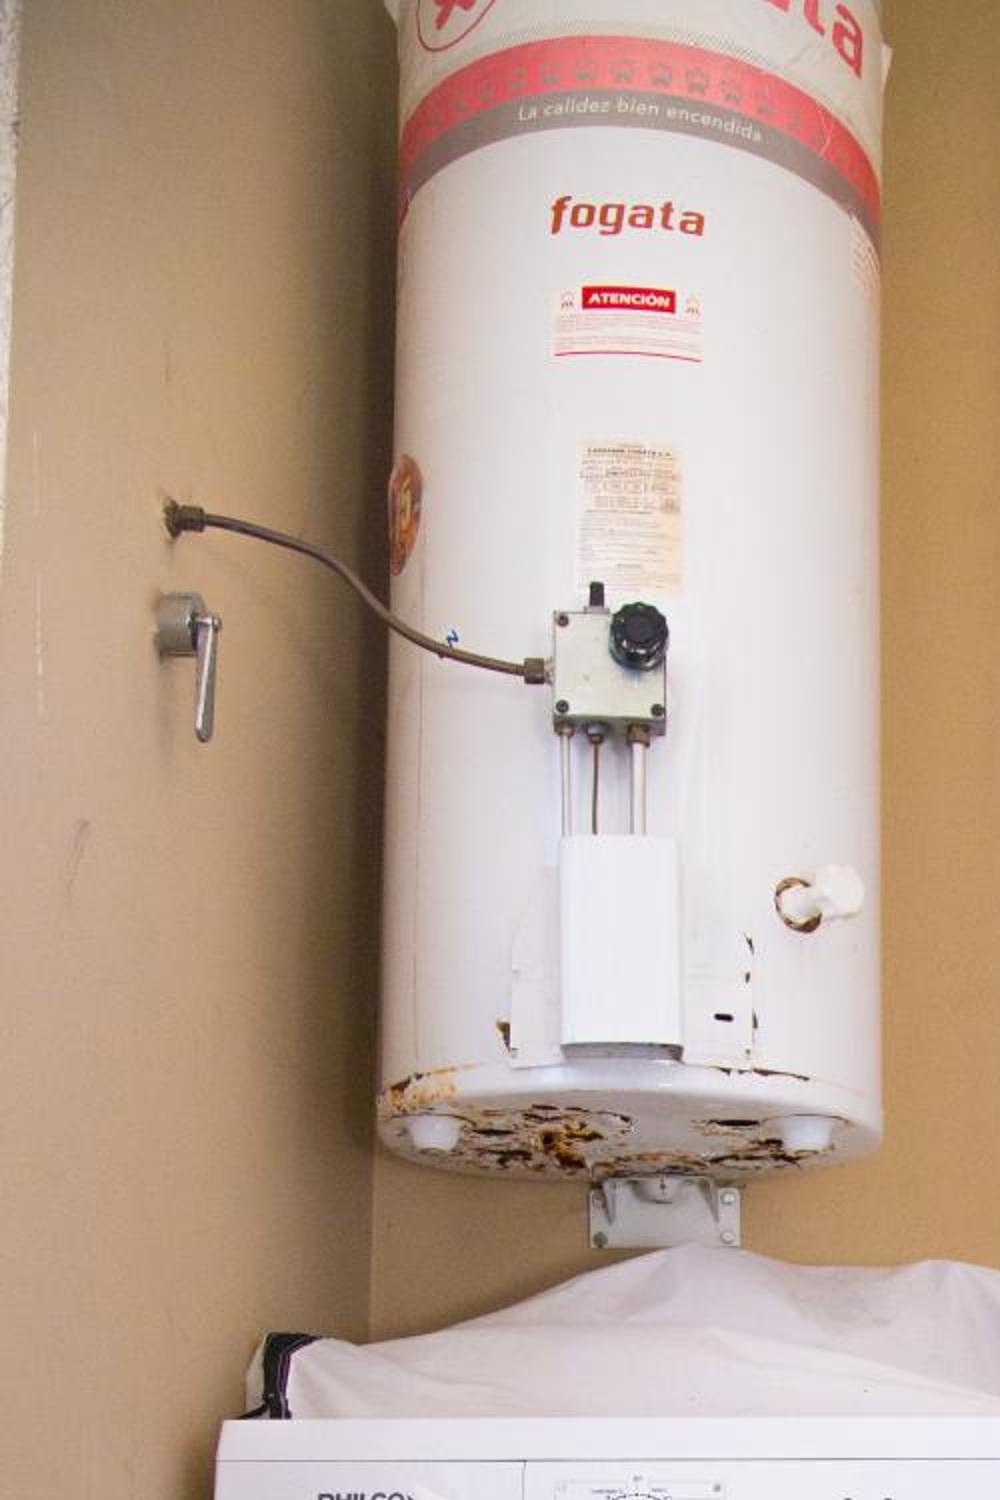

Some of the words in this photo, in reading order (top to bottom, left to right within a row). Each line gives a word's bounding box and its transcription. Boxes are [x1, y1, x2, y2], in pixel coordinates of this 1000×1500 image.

[518, 104, 538, 121] La
[543, 96, 610, 117] calidez
[616, 96, 660, 118] bien
[666, 107, 764, 143] encendida
[550, 195, 705, 237] fogata
[588, 291, 672, 309] ATENCIÓN
